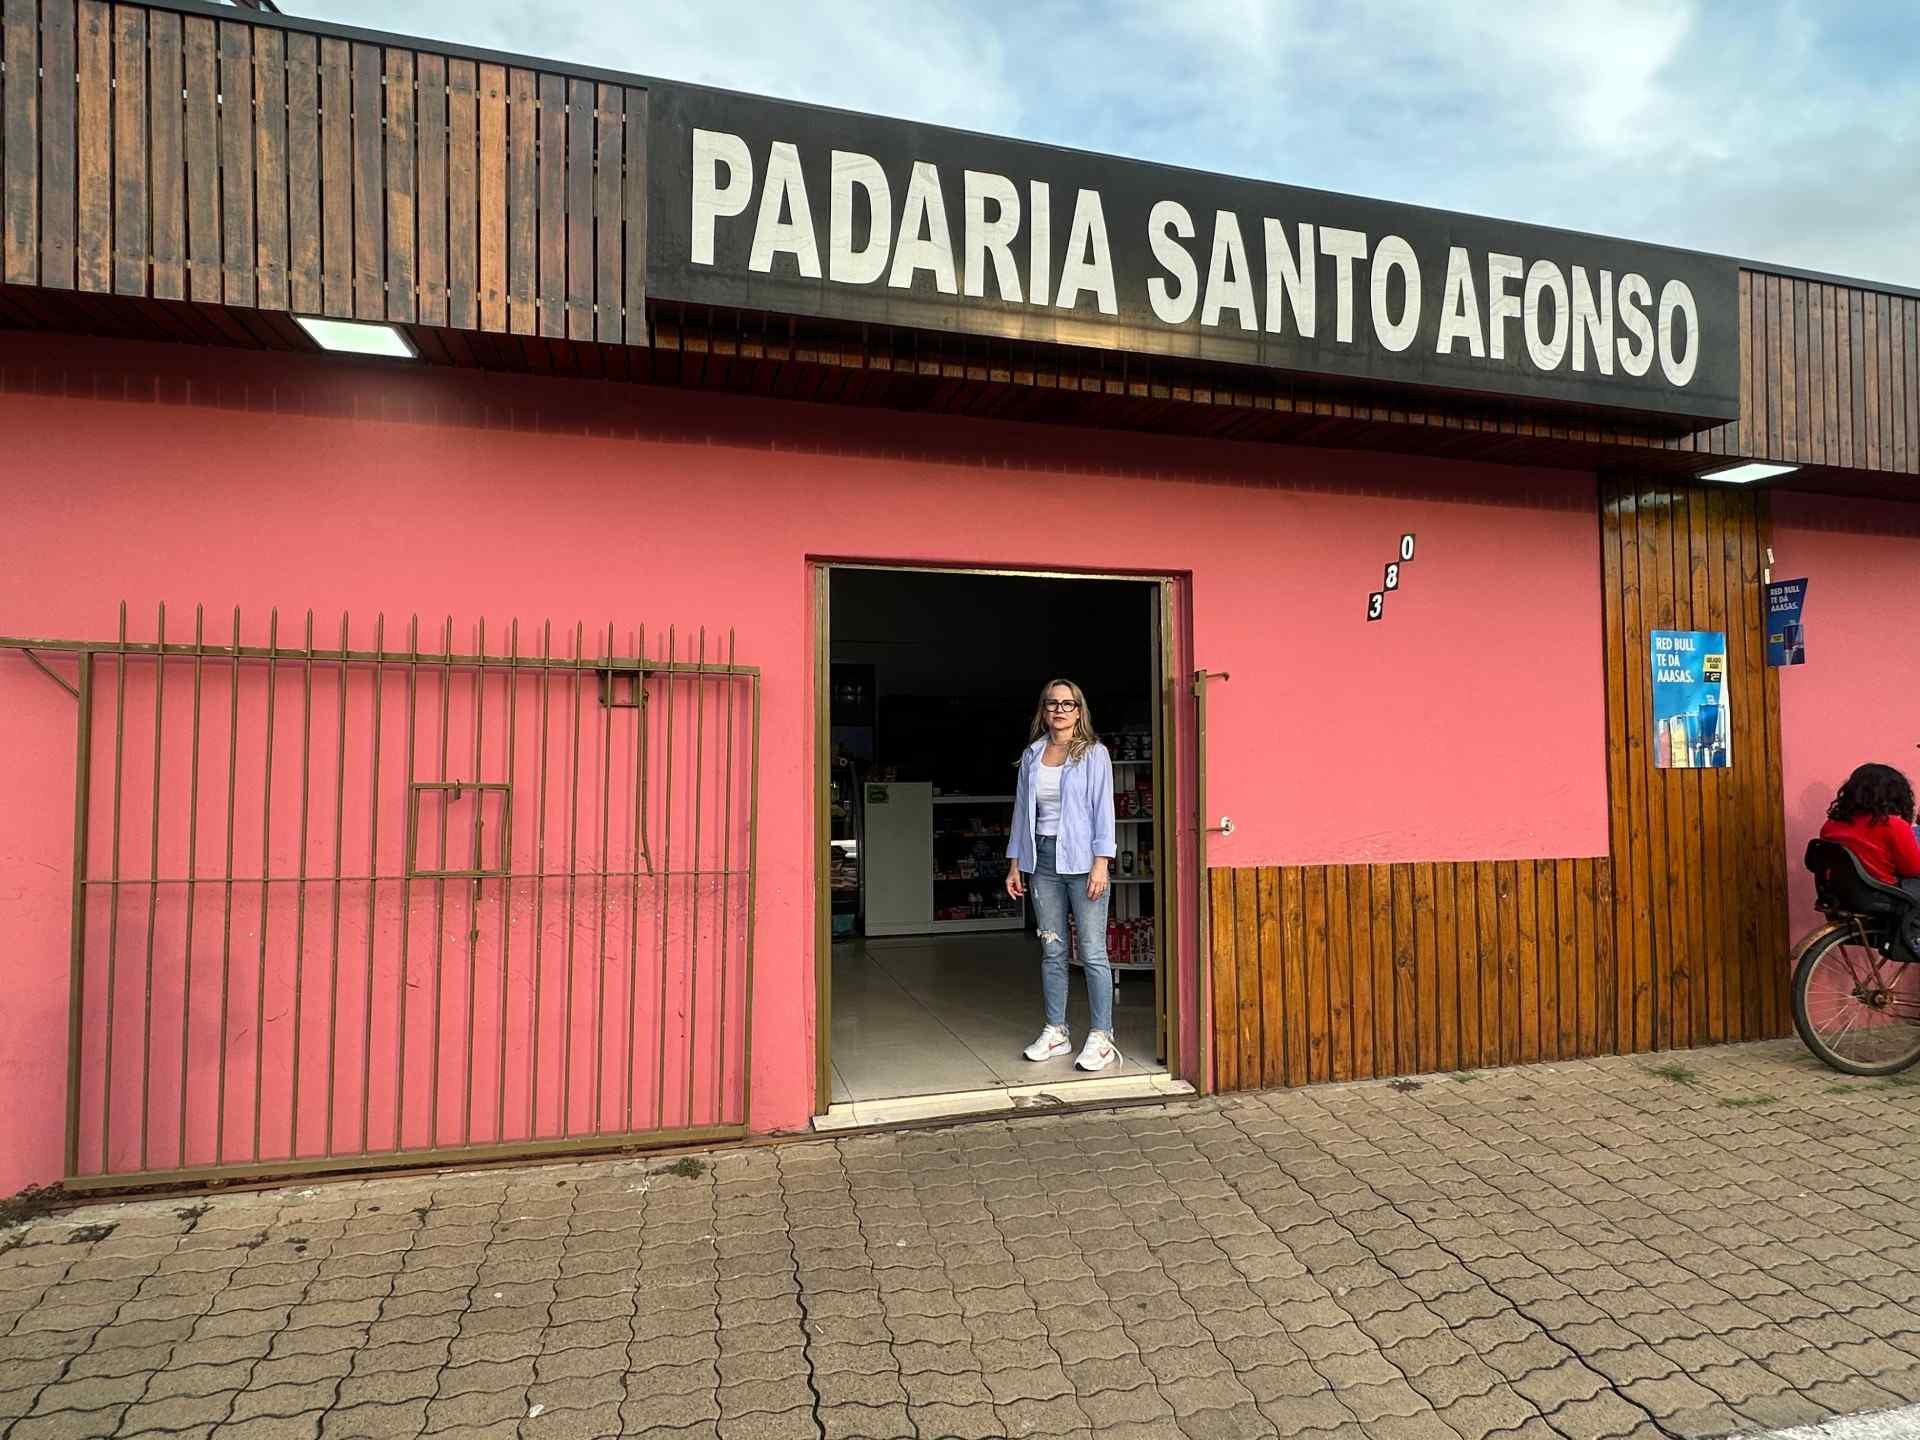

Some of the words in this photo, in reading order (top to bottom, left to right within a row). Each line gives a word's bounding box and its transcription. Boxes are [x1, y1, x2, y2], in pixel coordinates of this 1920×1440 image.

[690, 127, 1119, 316] PADARIA
[1146, 200, 1421, 352] SANTO
[1436, 246, 1699, 386] AFONSO
[1656, 637, 1673, 650] RED
[1674, 638, 1696, 651] BULL
[1656, 654, 1666, 667] TE
[1668, 651, 1680, 667] DÁ
